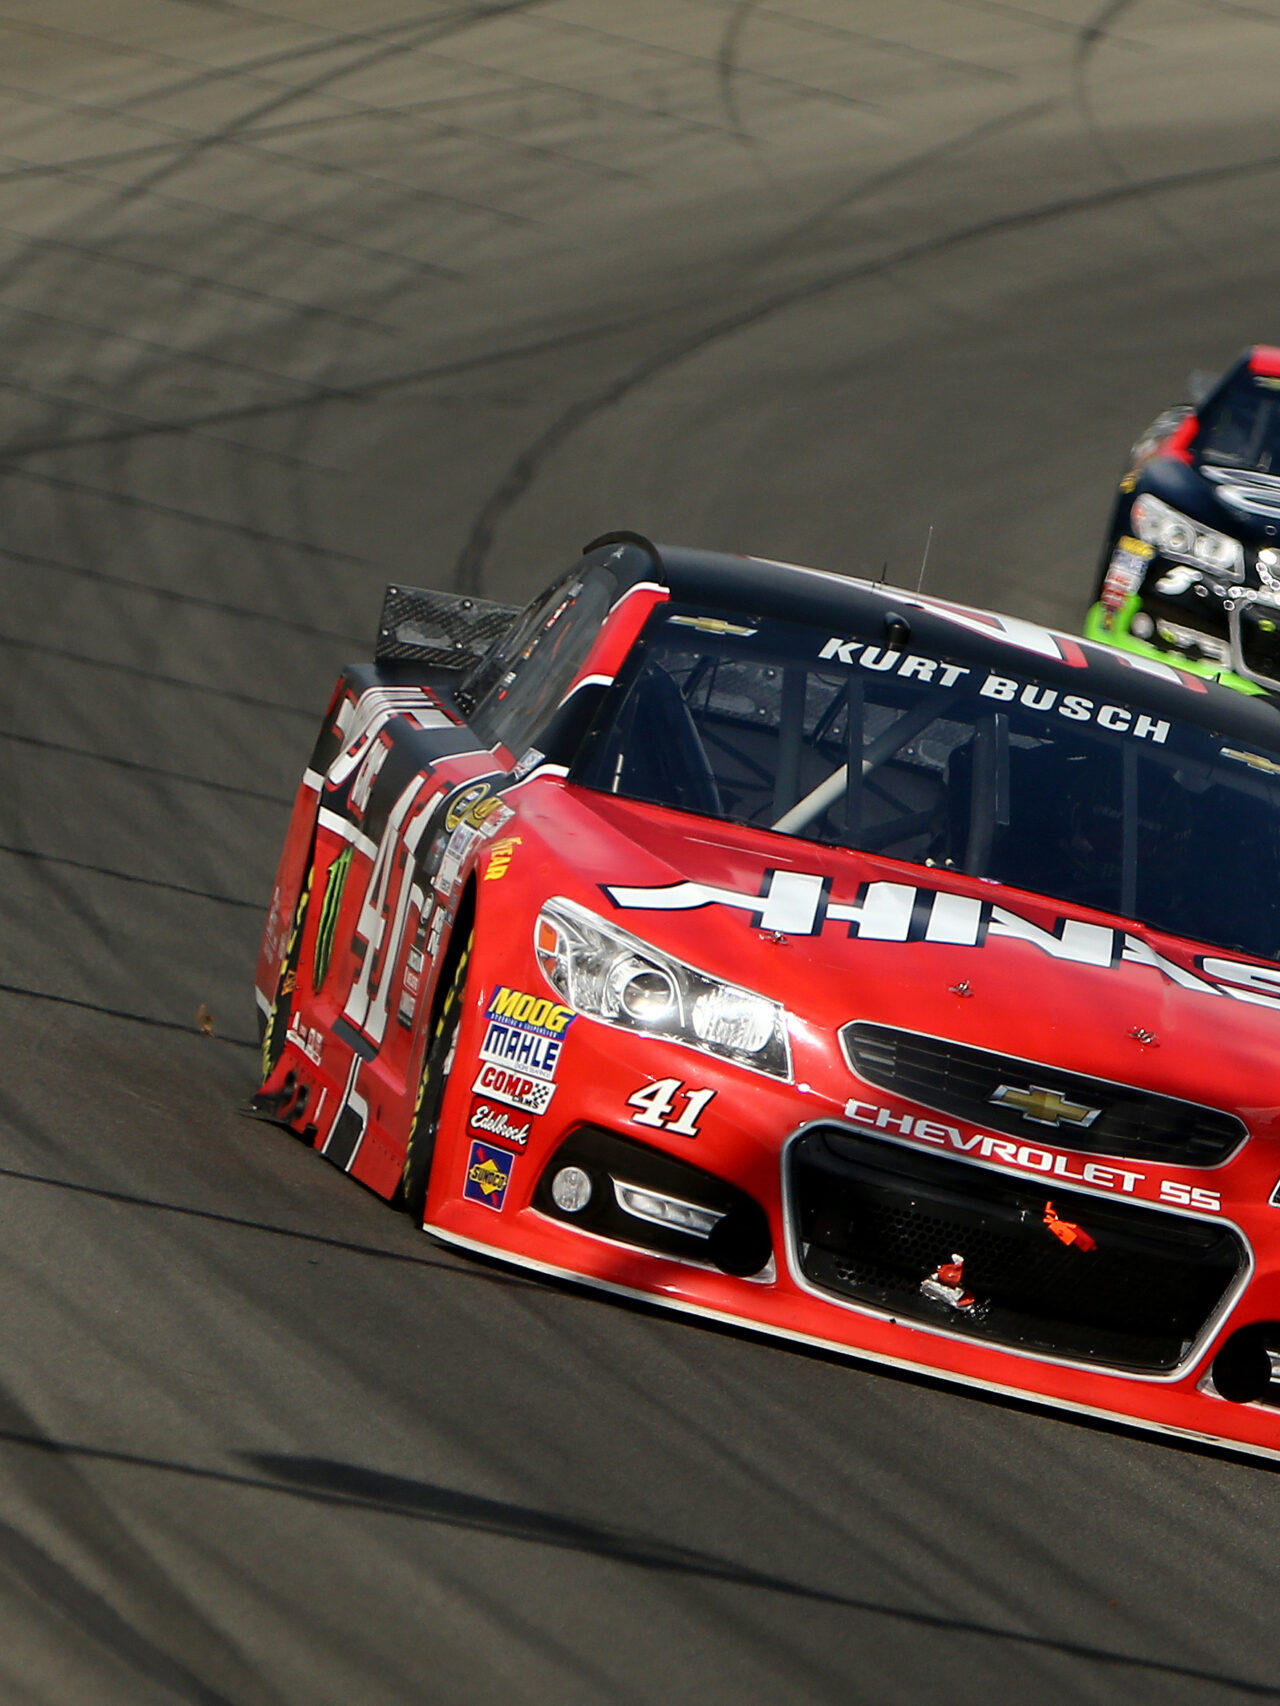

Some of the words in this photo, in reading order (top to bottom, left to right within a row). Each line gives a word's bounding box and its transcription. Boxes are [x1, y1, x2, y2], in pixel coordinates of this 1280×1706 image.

[817, 636, 970, 687] KURT
[979, 675, 1172, 745] BUSCH
[488, 986, 577, 1033] MOOG
[484, 1023, 560, 1072] MAHLE
[480, 1066, 534, 1098] COMP
[512, 1093, 540, 1110] CAMS
[470, 1105, 531, 1145] Edelbrock
[627, 1077, 718, 1136] 41
[470, 1165, 507, 1188] SUNOCO
[845, 1098, 1146, 1192] CHEVROLET
[1160, 1179, 1222, 1212] SS
